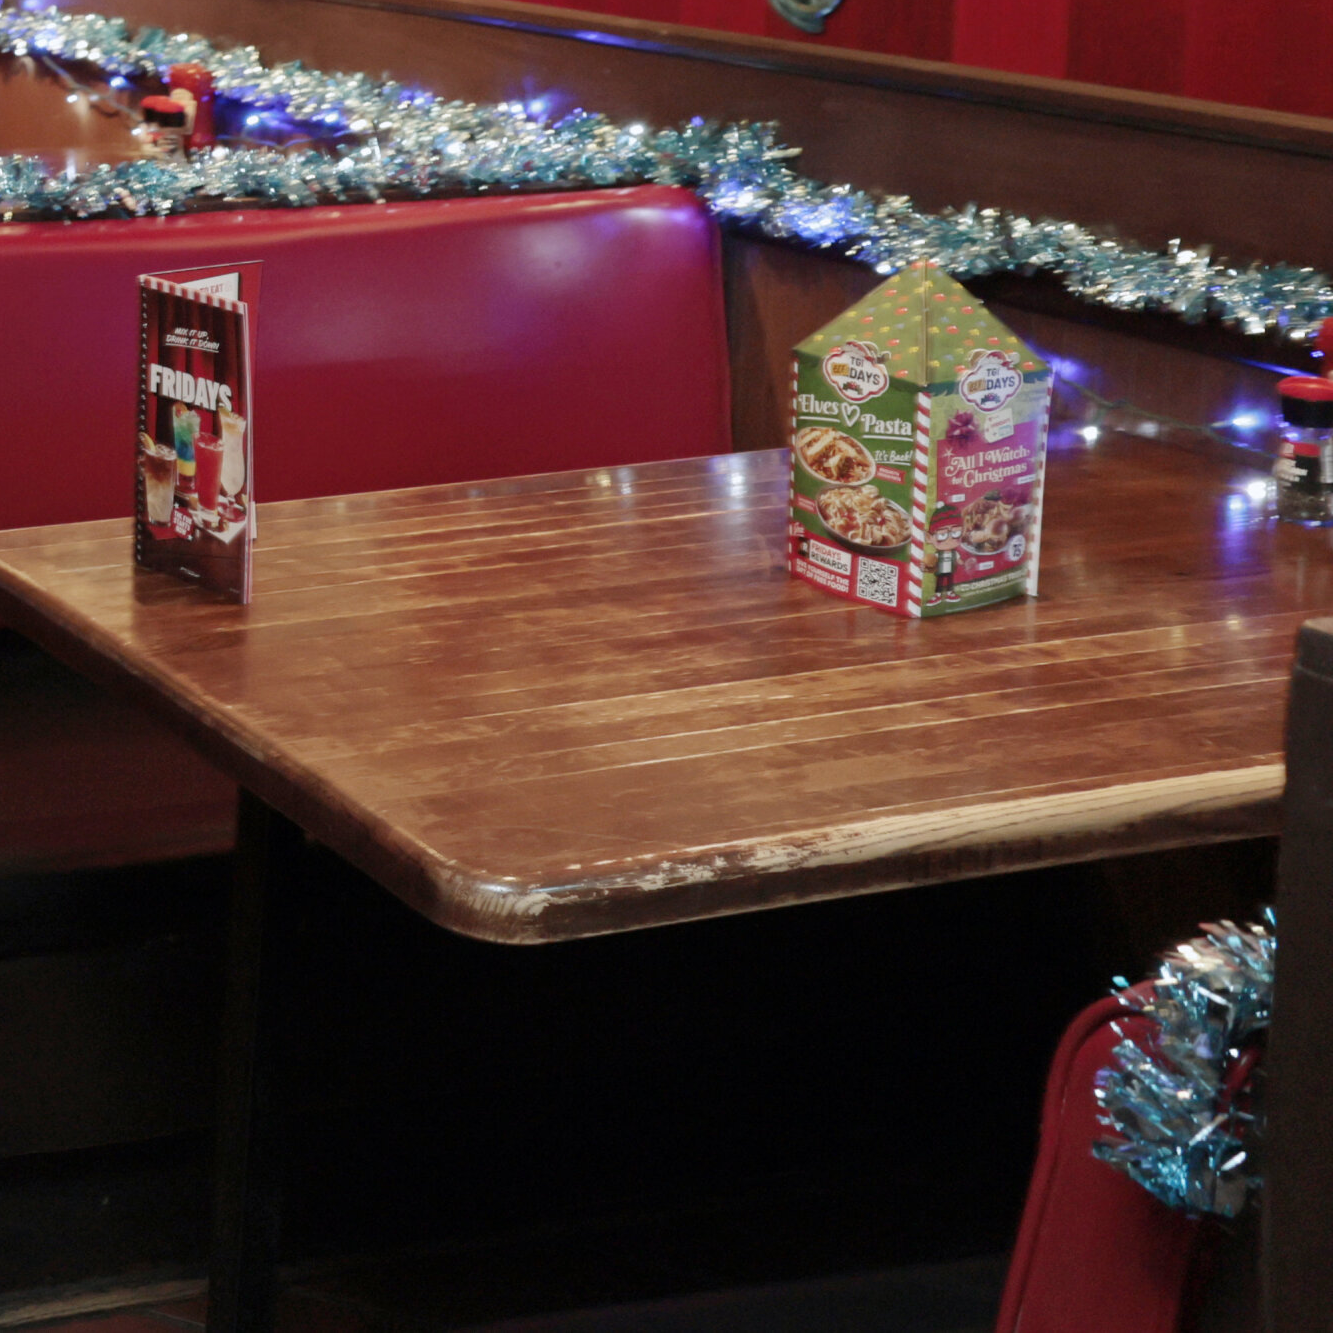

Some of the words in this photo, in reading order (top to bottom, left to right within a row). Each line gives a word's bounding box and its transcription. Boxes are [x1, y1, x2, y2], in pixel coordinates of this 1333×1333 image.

[150, 363, 233, 412] FRIDAYS
[798, 394, 839, 415] Elves
[860, 413, 912, 436] Pasta
[945, 455, 976, 477] All
[963, 462, 1028, 487] Christmas
[811, 543, 842, 561] FRIDAYS
[811, 552, 849, 572] REWARDS
